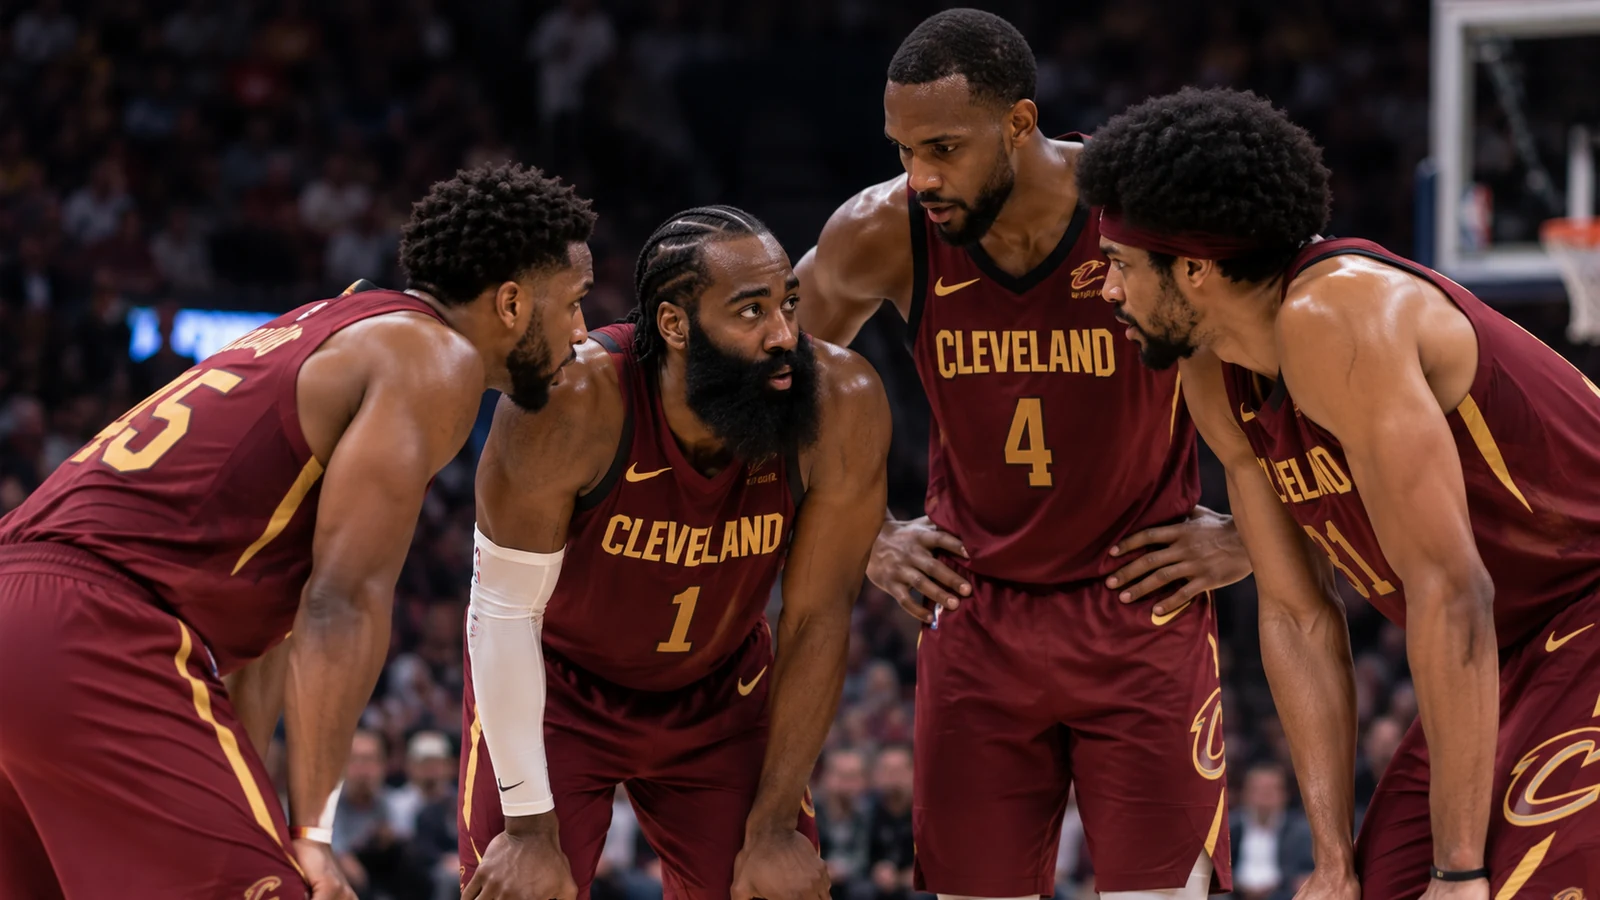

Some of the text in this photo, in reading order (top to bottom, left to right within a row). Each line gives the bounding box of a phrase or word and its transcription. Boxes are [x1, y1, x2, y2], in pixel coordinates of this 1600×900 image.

[935, 328, 1116, 379] CLEVELAND
[69, 368, 246, 473] 45
[1004, 397, 1053, 487] 4
[601, 512, 784, 567] CLEVELAND
[656, 586, 701, 653] 1
